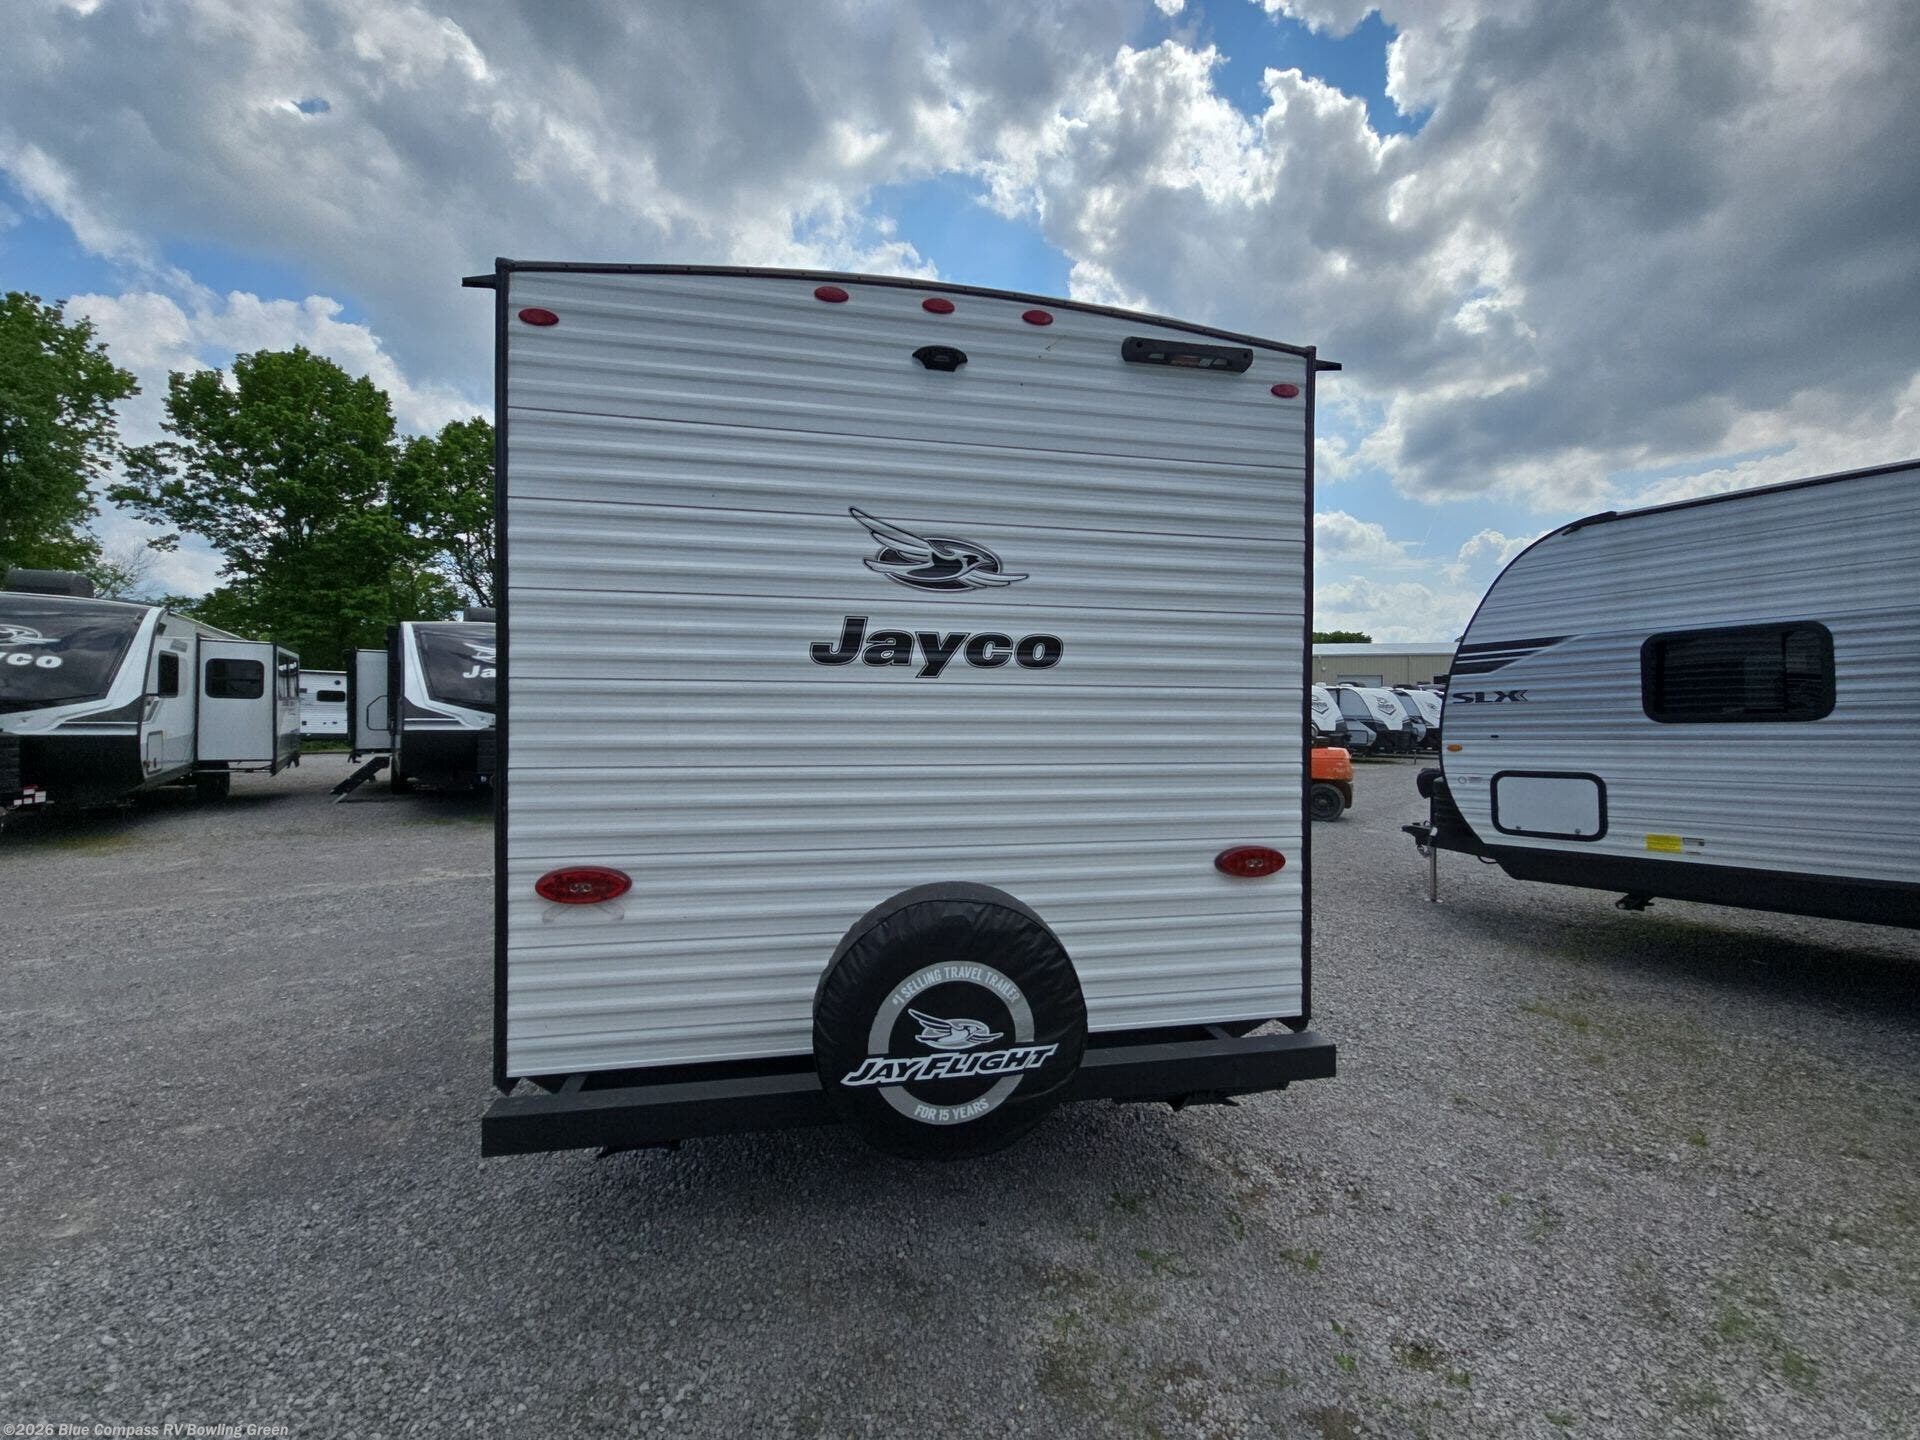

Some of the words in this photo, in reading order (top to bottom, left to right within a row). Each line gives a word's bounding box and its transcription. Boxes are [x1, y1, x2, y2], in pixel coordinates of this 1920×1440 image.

[810, 616, 1064, 679] Jayco
[900, 969, 942, 998] SELLING
[943, 965, 982, 981] TRAVEL
[983, 971, 1020, 1003] TRAILER
[913, 1104, 937, 1120] FOR
[938, 1108, 950, 1121] 15
[952, 1098, 989, 1120] YEARS
